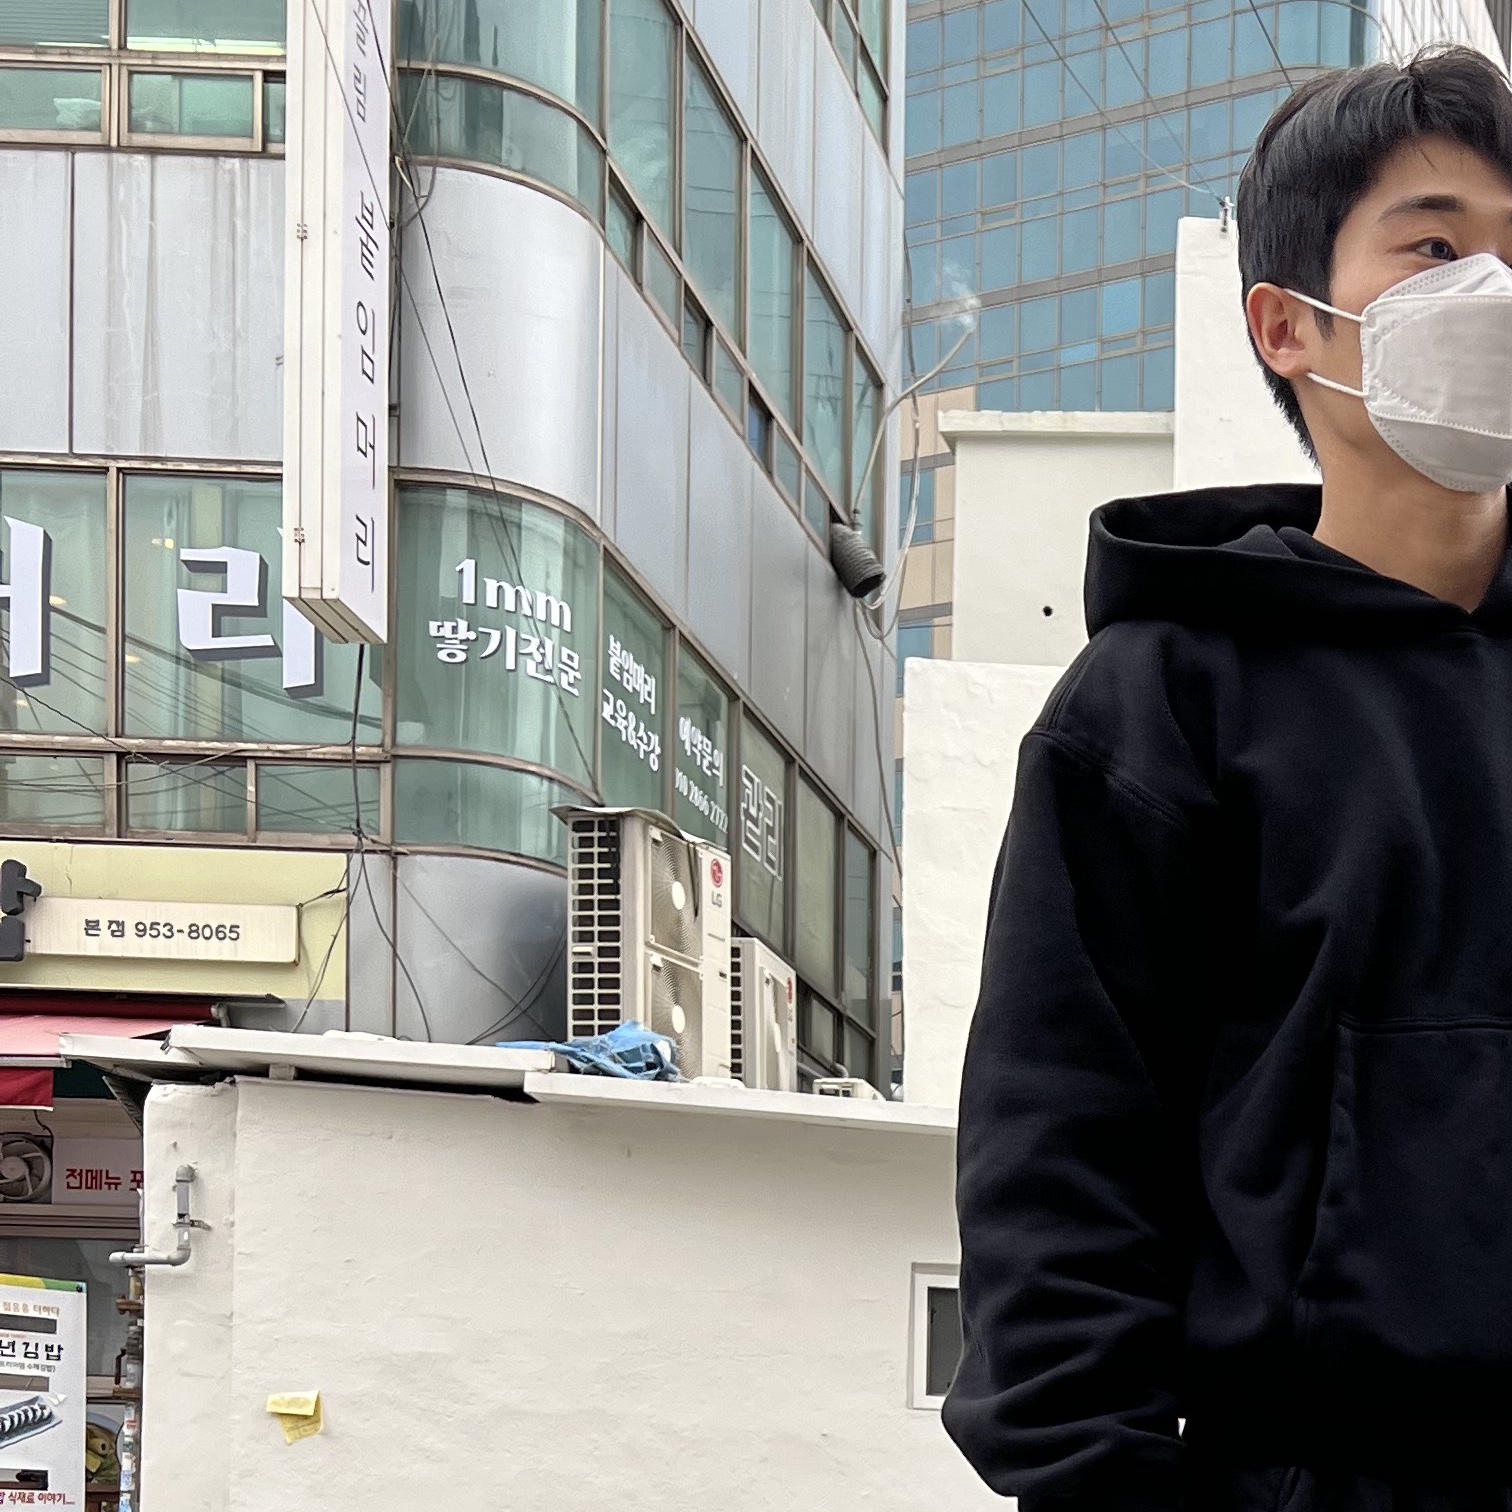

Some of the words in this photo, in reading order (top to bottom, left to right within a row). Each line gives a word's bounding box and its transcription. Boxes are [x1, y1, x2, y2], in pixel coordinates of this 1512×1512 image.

[354, 190, 379, 594] 붙임머리
[455, 558, 573, 633] 1mm
[428, 617, 582, 697] 땋기전문
[607, 634, 656, 714] 붙임머리
[601, 688, 662, 773] 교육&수강
[678, 716, 724, 787] 예약문의
[134, 921, 241, 941] 953-8065
[65, 1168, 122, 1191] 전메뉴
[8, 1491, 35, 1505] 식재료
